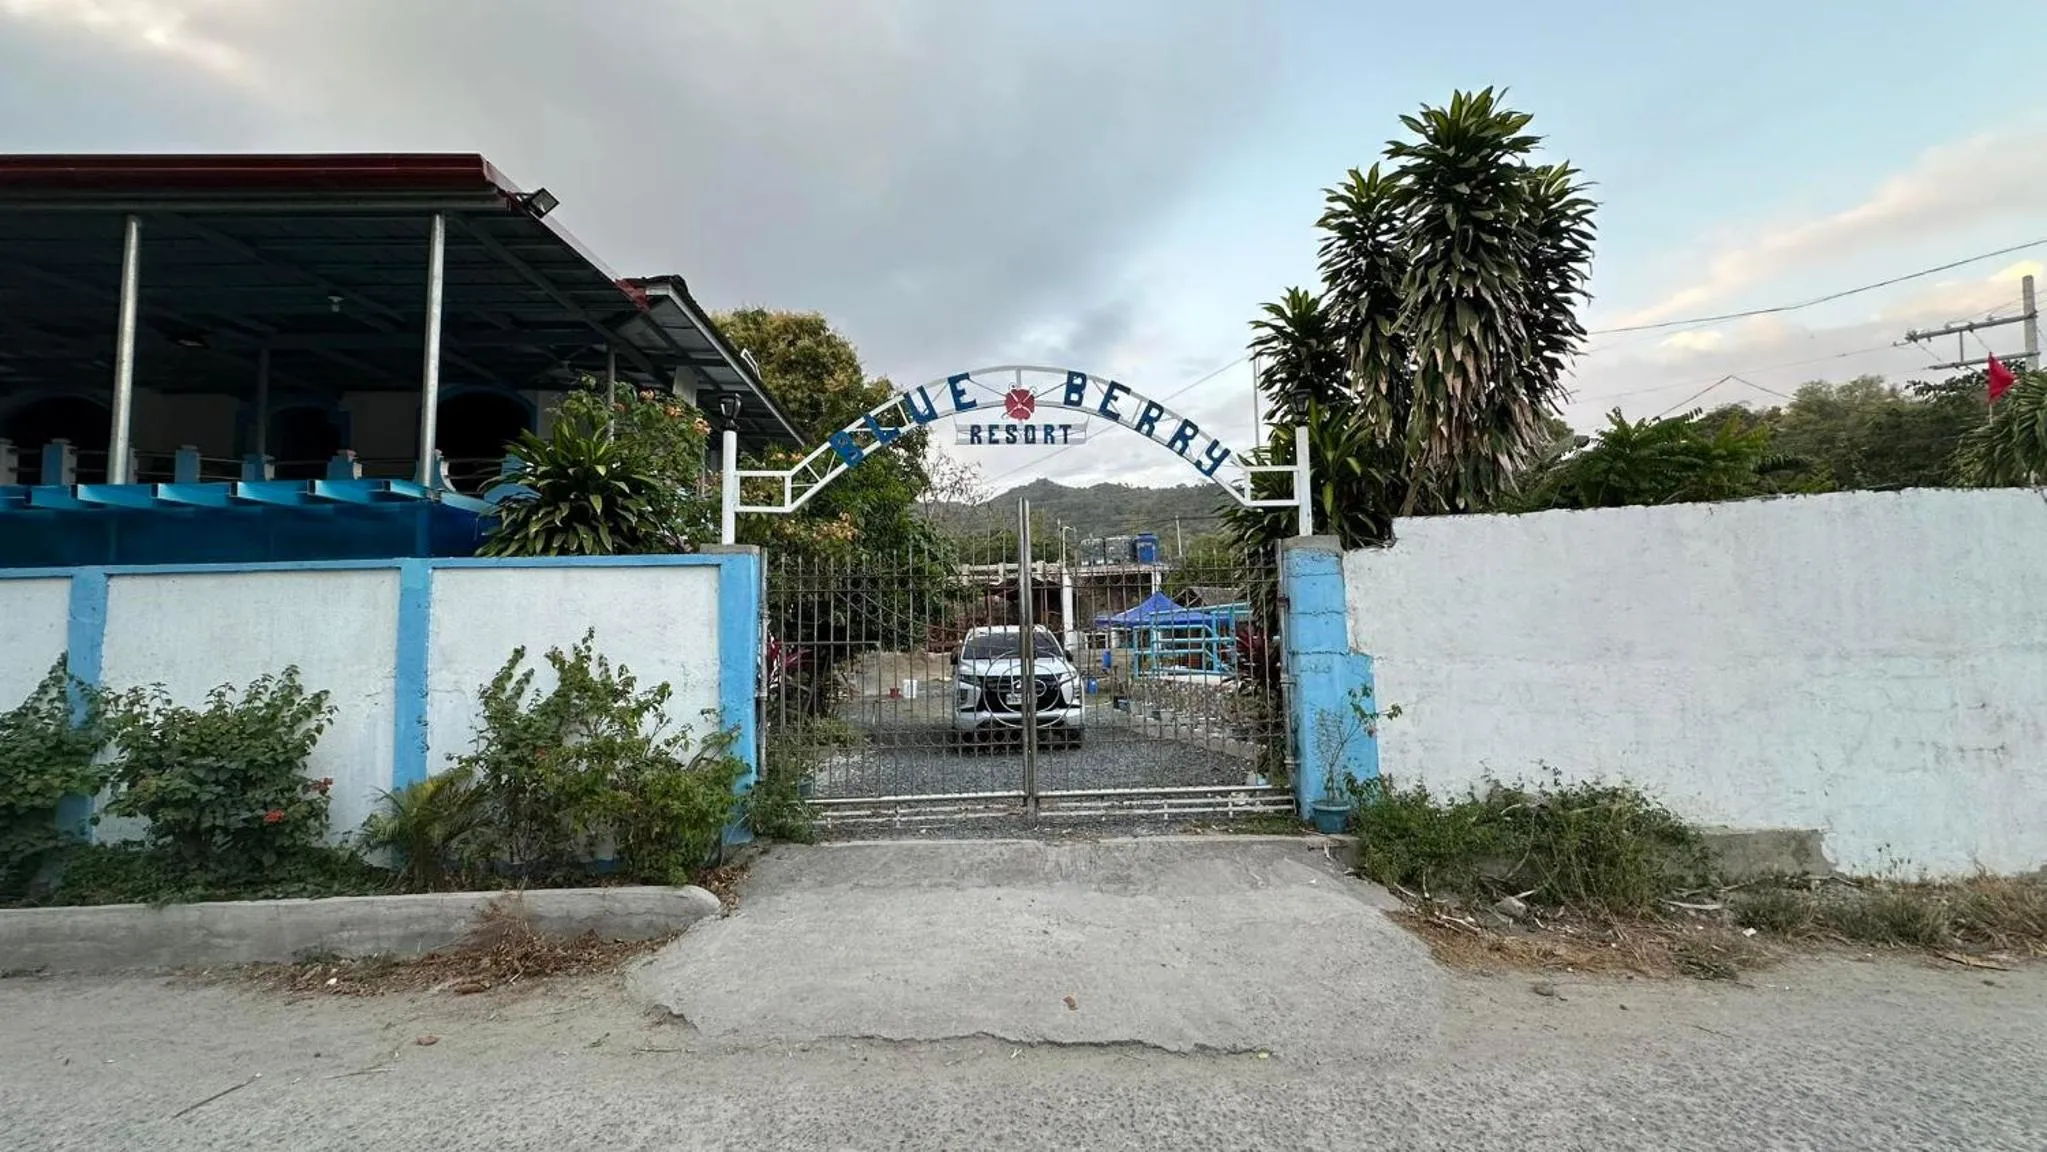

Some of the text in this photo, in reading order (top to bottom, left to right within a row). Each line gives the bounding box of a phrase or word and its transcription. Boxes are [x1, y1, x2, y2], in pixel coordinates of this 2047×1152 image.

[829, 371, 1231, 477] BLUE BERRY
[970, 424, 1071, 444] RESORT
